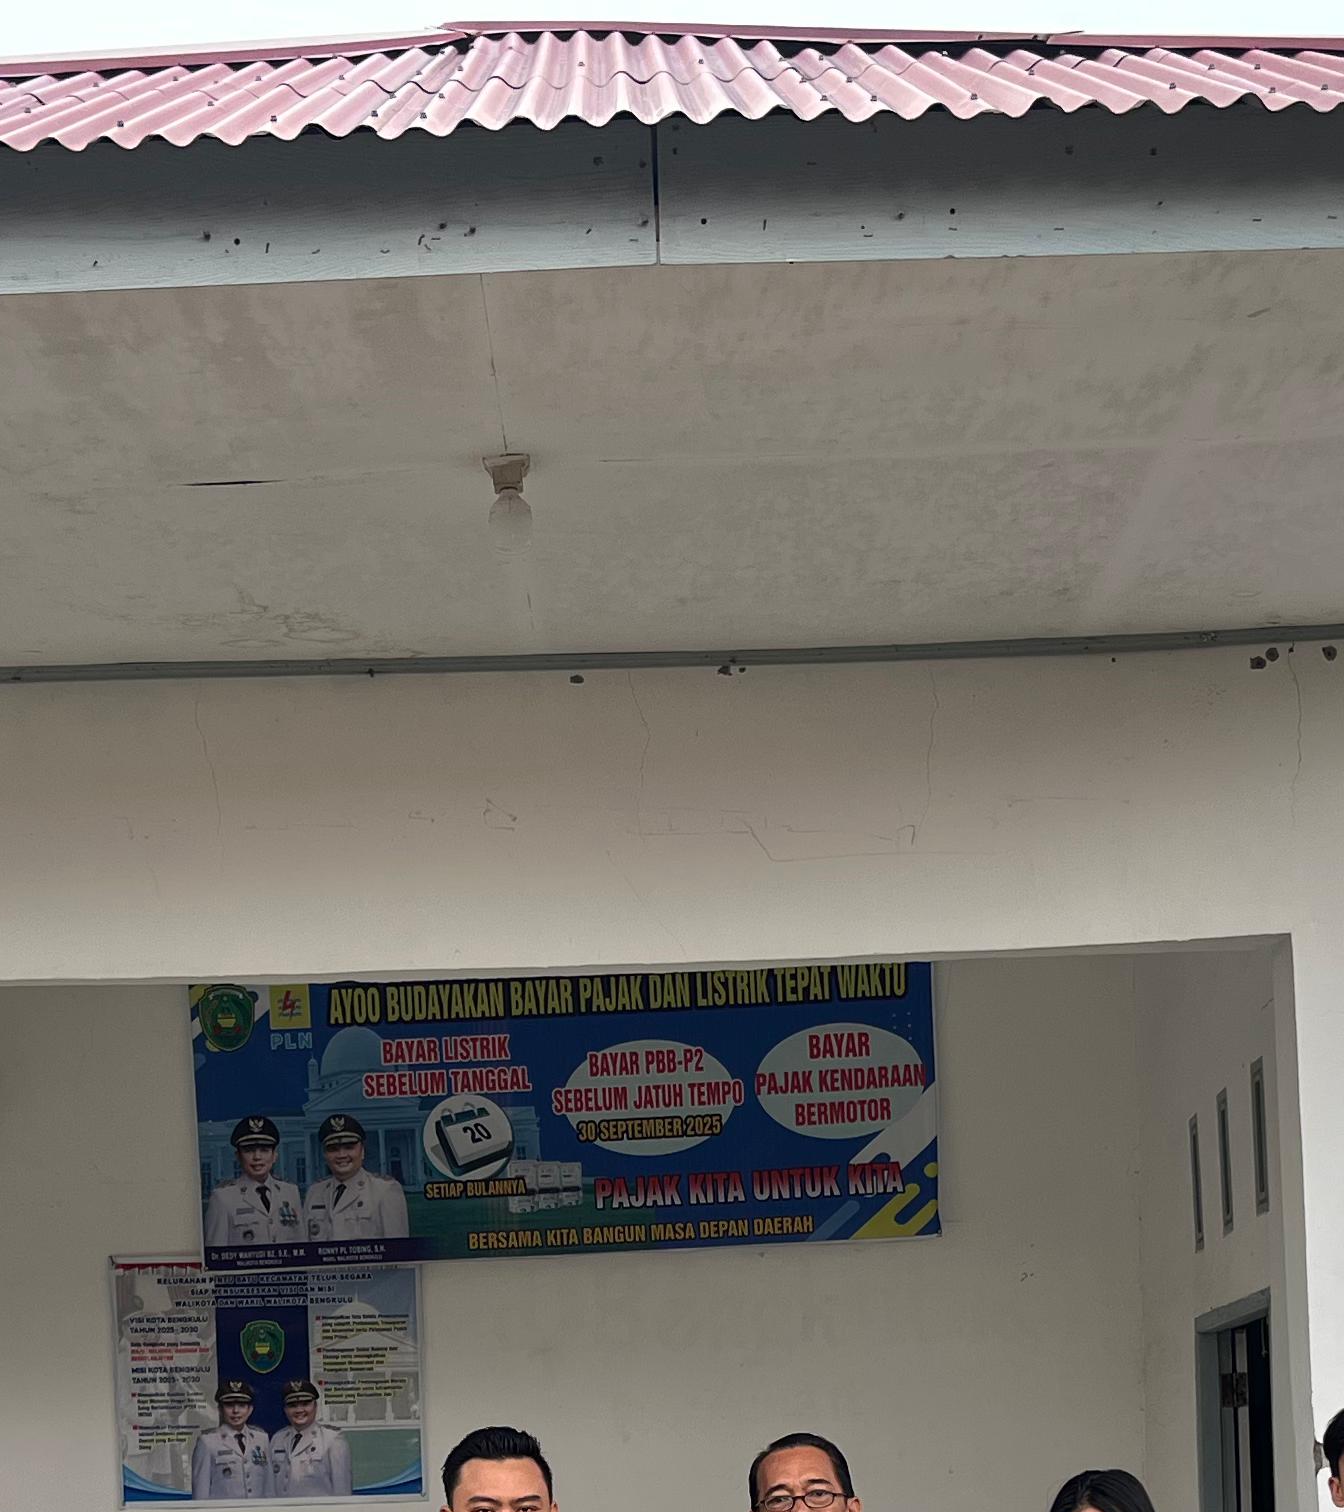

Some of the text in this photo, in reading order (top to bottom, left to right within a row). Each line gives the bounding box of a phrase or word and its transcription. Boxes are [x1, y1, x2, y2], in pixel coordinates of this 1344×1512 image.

[329, 963, 907, 1024] AYOO BUDAYAKAN BAYAR PAJAK DAN LISTRIK TEPAT WAKTU
[270, 1032, 313, 1050] PLN
[382, 1034, 510, 1064] BAYAR LISTRIK
[808, 1032, 870, 1059] BAYAR
[588, 1047, 704, 1077] BAYAR PBB-P2
[363, 1066, 531, 1098] SEBELUM TANGGAL
[755, 1063, 927, 1096] PAJAK KENDARAAN
[552, 1079, 744, 1114] SEBELUM JATUH TEMPO
[794, 1098, 892, 1127] BERMOTOR
[462, 1122, 491, 1144] 20
[578, 1115, 721, 1141] 30 SEPTEMBER 2025
[424, 1178, 527, 1199] SETIAP BULANNYA
[594, 1160, 904, 1209] PAJAK KITA UNTUK KITA
[468, 1215, 814, 1250] BERSAMA KITA BANGUN MASA DEPAN DAERAH
